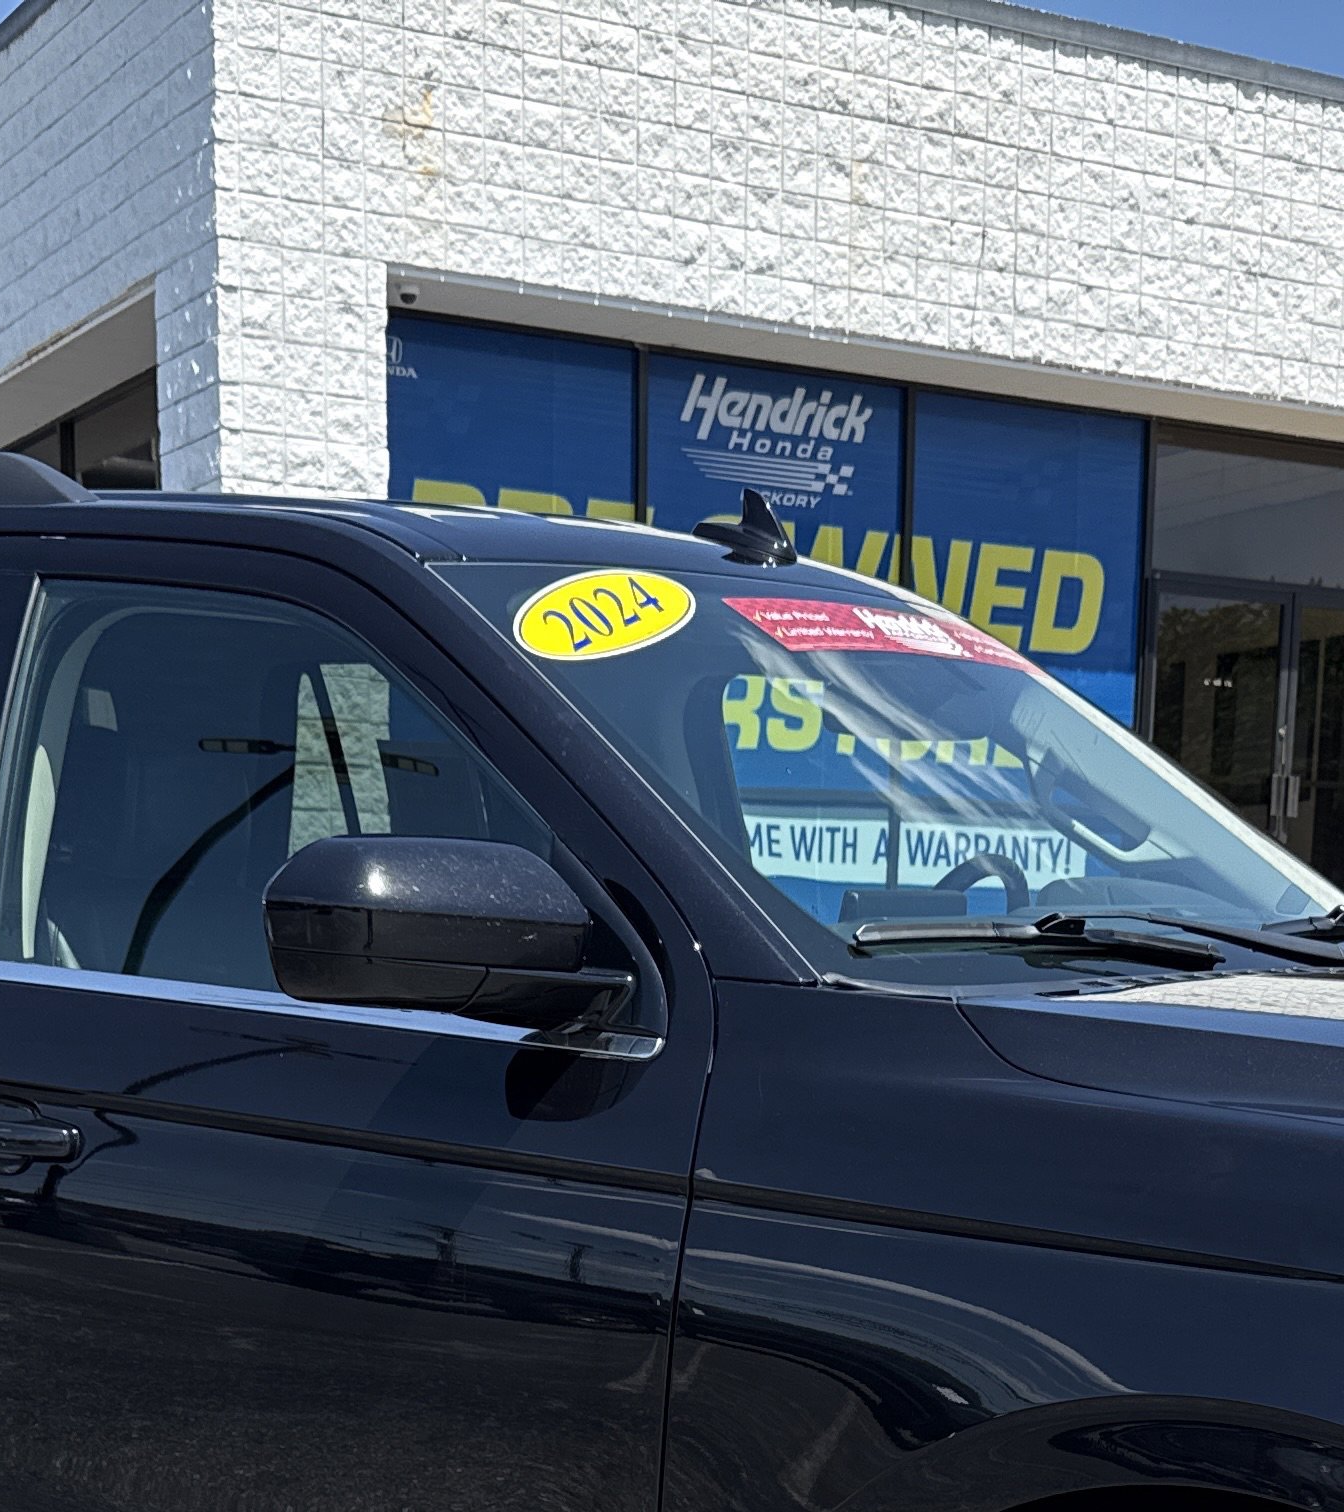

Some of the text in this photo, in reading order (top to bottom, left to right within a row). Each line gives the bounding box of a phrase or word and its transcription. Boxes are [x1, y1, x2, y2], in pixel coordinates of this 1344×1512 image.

[387, 366, 418, 379] NDA
[680, 373, 873, 443] Hendrick
[728, 430, 833, 461] Honda
[740, 488, 821, 508] CKORY
[543, 577, 664, 652] 2024
[790, 825, 858, 864] WITH
[872, 827, 888, 865] A
